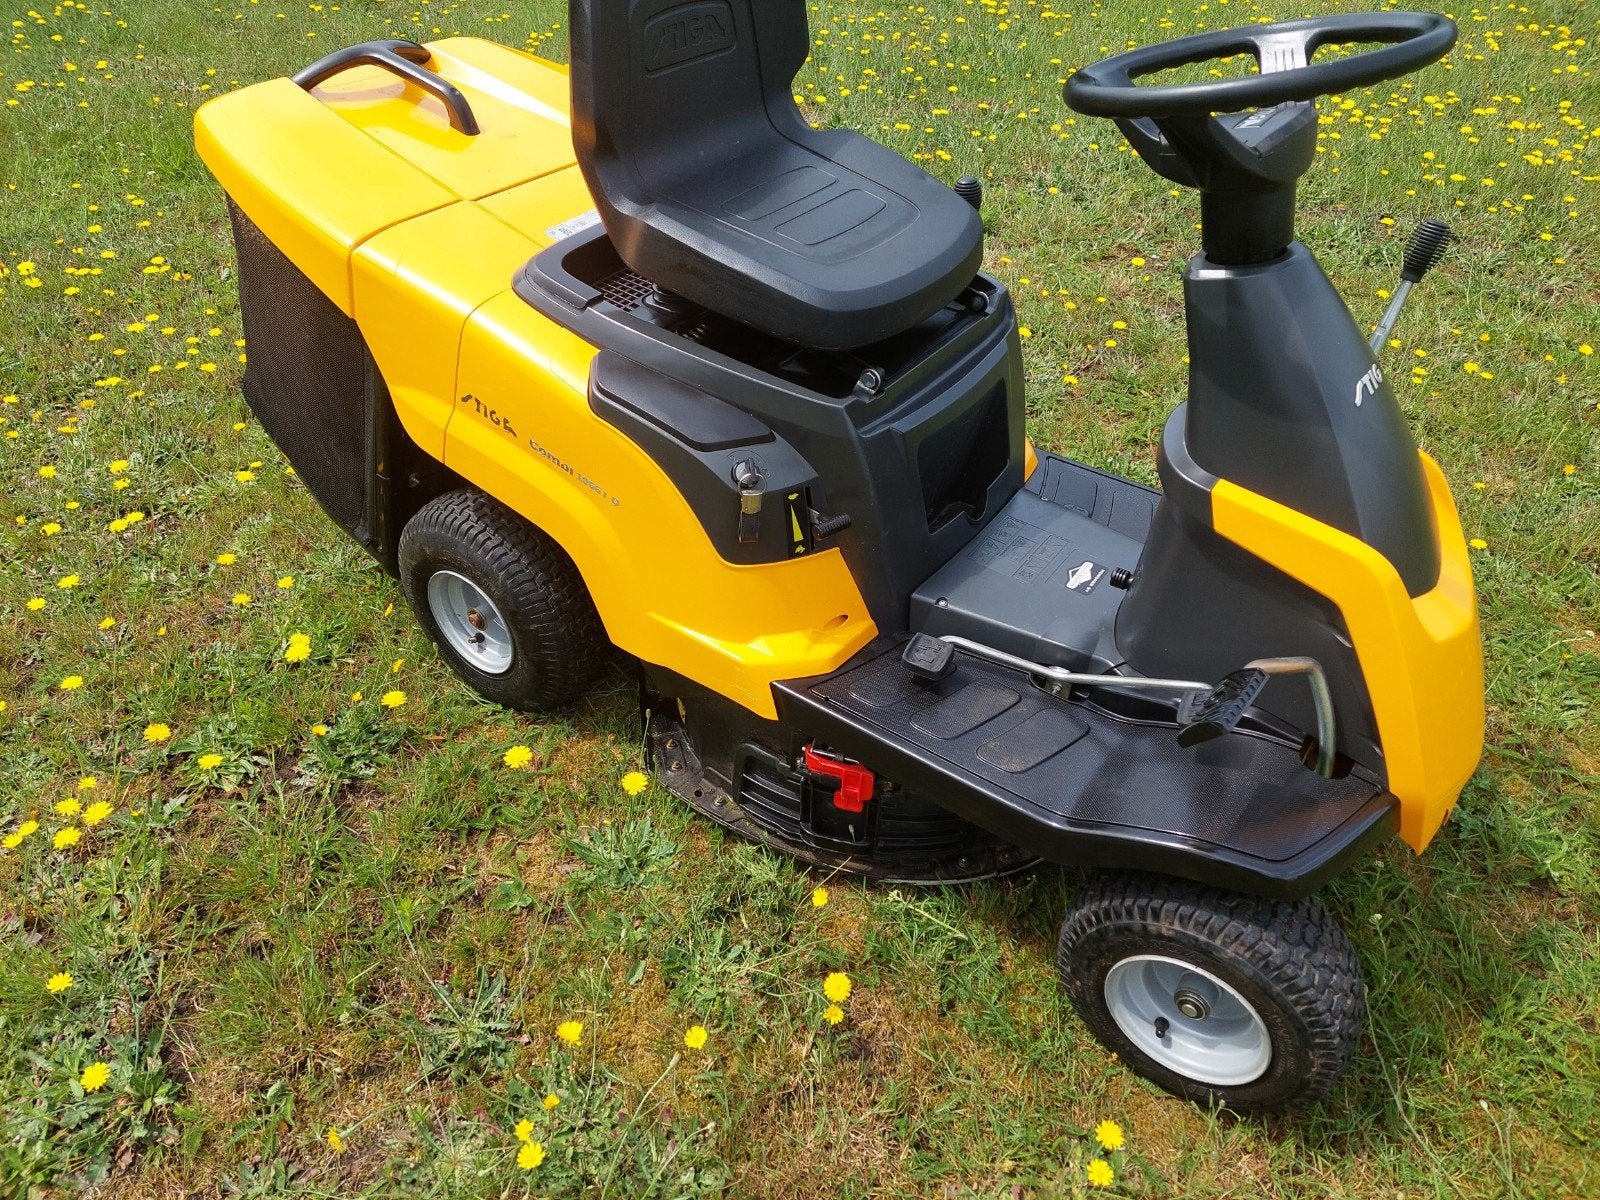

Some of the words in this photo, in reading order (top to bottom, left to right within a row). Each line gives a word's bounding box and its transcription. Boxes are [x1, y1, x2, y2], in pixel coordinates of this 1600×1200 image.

[652, 13, 725, 60] STIGA
[1354, 363, 1383, 407] STIG
[461, 394, 517, 438] STIGA
